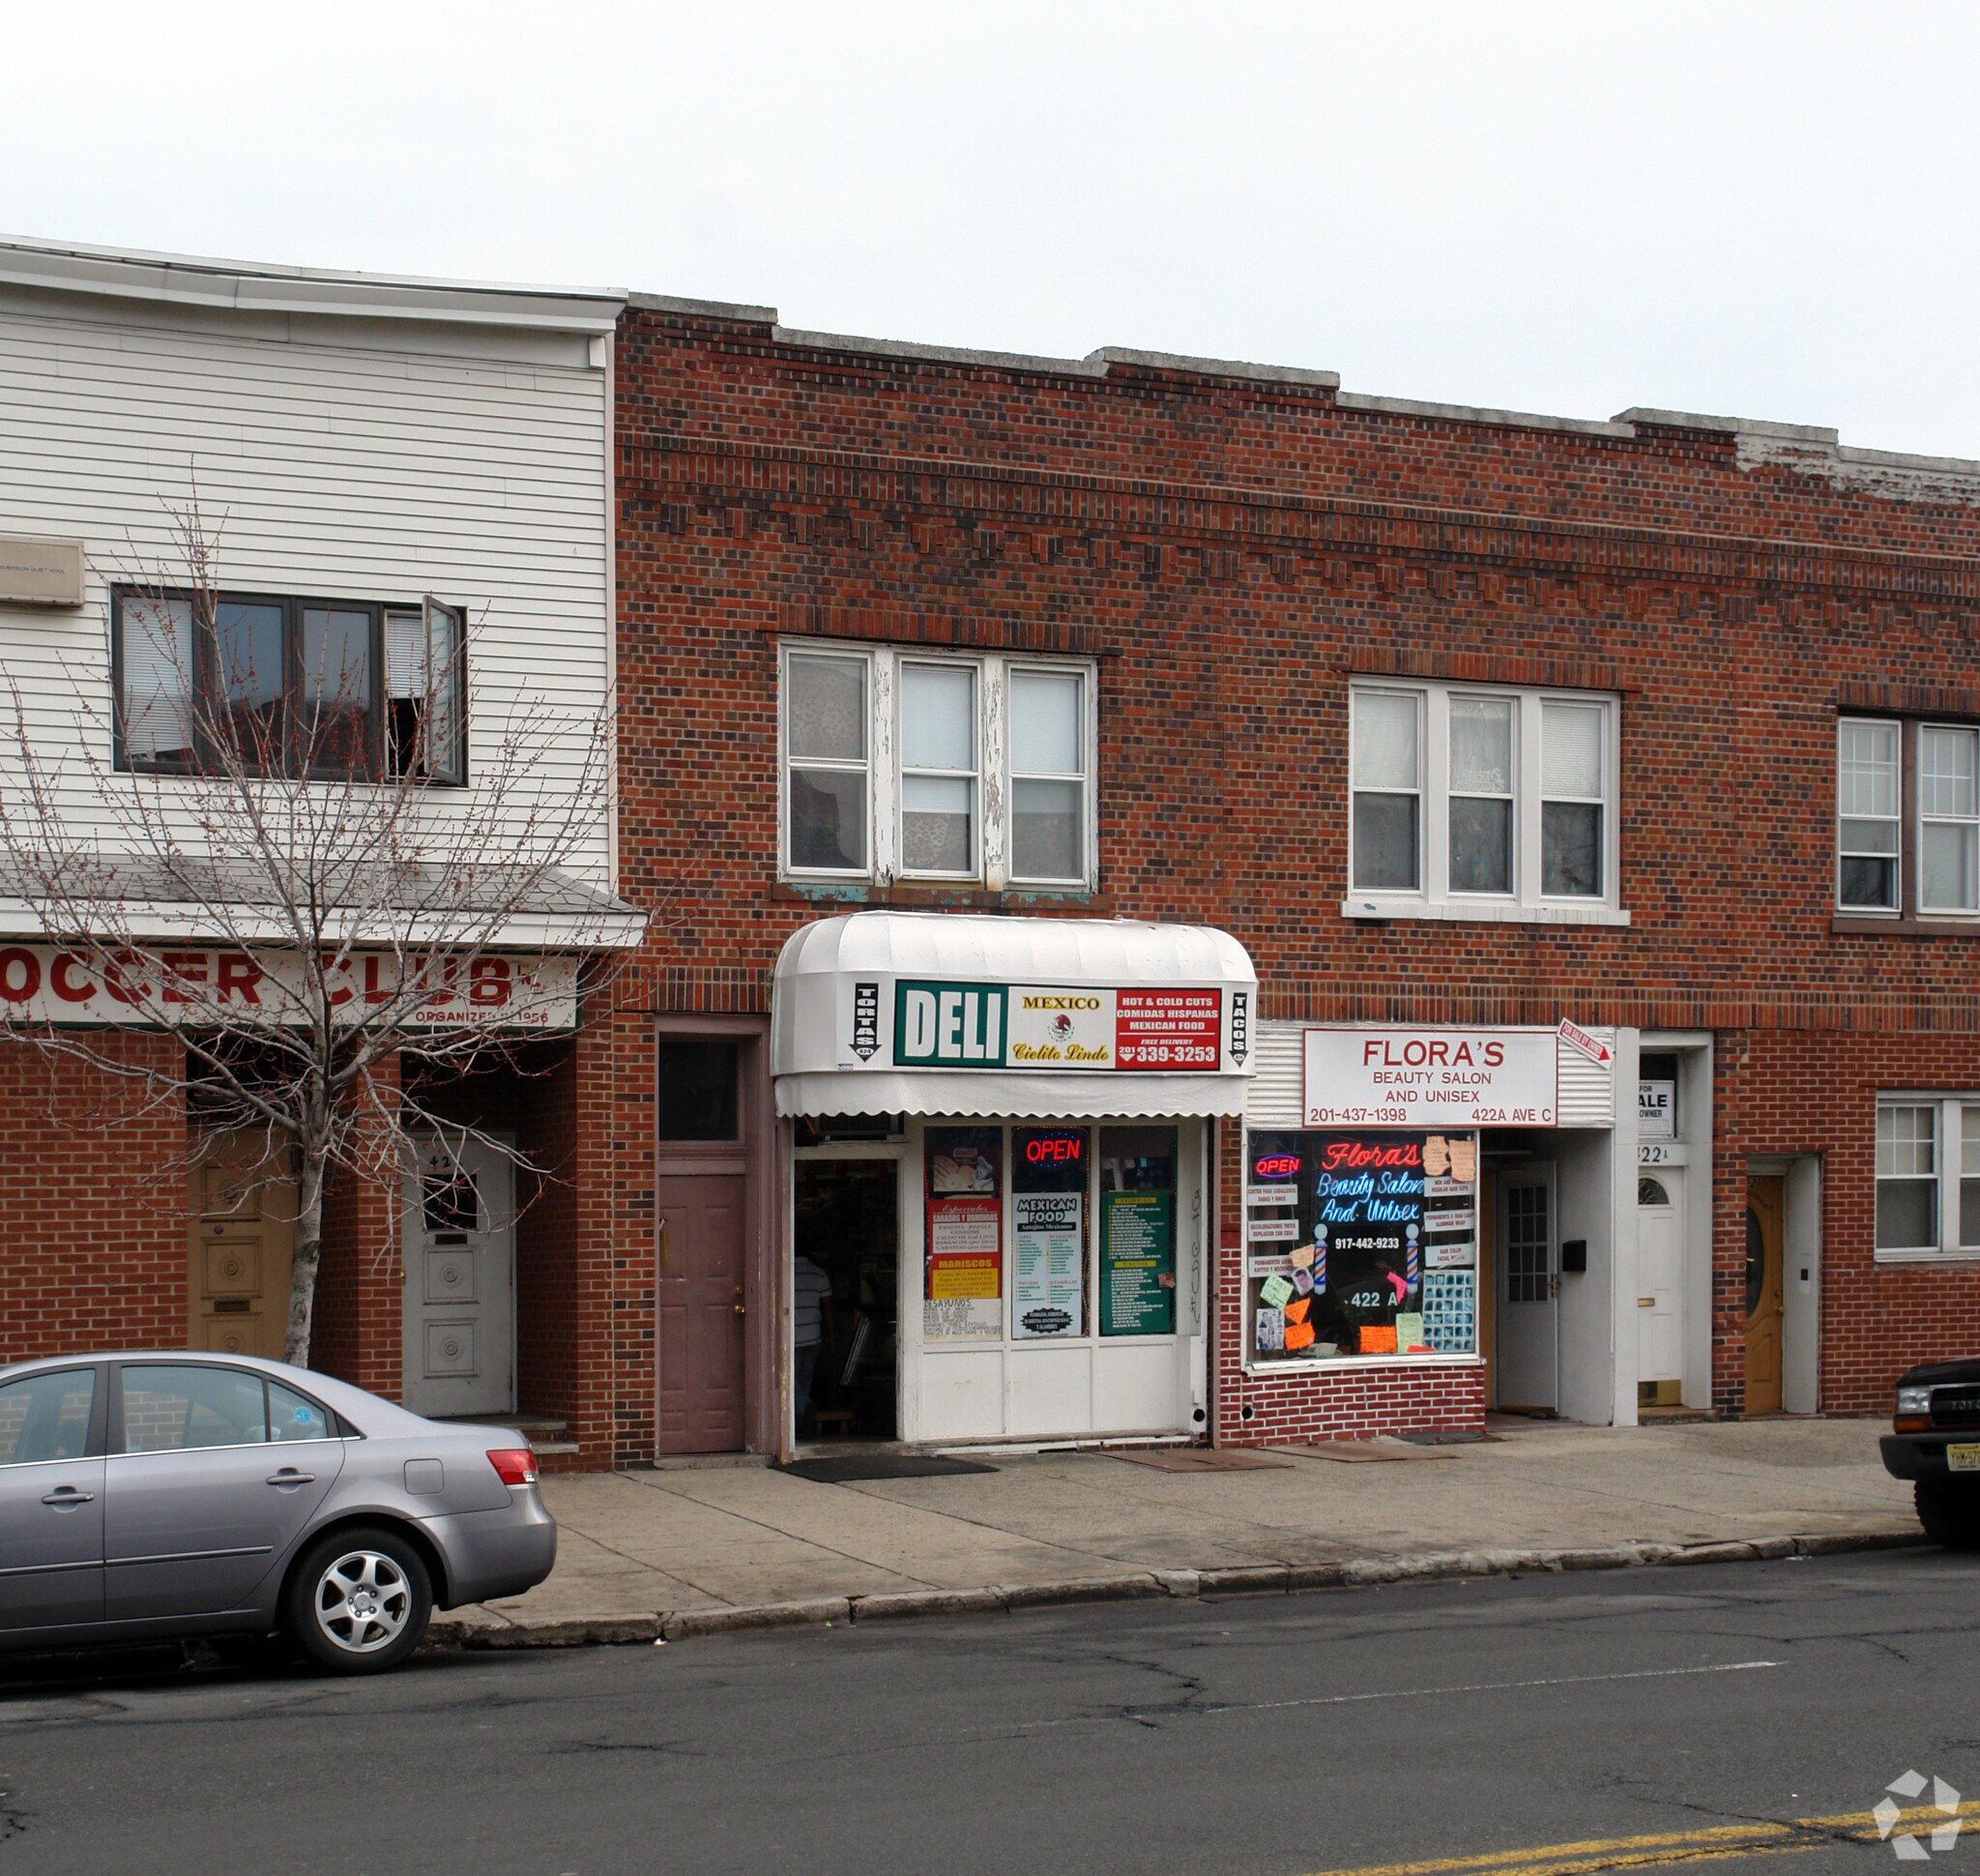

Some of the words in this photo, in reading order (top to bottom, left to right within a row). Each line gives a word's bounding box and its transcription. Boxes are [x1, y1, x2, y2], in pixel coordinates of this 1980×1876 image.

[306, 952, 513, 1007] CLUB
[1022, 996, 1100, 1010] MEXICO
[416, 1011, 496, 1023] ORGANIZE
[856, 988, 876, 1045] TORTAS
[1117, 1010, 1165, 1018] COMIDAS
[1167, 1010, 1218, 1018] HISPANAS
[905, 989, 1002, 1060] DELI
[1129, 1021, 1176, 1030] MEXICAN
[1179, 1021, 1205, 1030] FOOD
[1233, 997, 1245, 1050] TACOS
[1562, 1023, 1573, 1035] FOR
[1571, 1029, 1583, 1041] SALE
[1581, 1036, 1589, 1045] BY
[1587, 1040, 1602, 1055] OWNER
[1012, 1043, 1061, 1060] Cielito
[1063, 1044, 1109, 1061] Lindo
[1137, 1046, 1215, 1062] 339-3253
[1363, 1040, 1505, 1067] FLORA'S
[1373, 1071, 1433, 1084] BEAUTY
[1441, 1071, 1492, 1084] SALON
[1385, 1091, 1418, 1102] AND
[1426, 1091, 1480, 1102] UNISEX
[1310, 1108, 1407, 1122] 201-437-1398
[1471, 1108, 1506, 1122] 422A
[1512, 1109, 1535, 1122] AVE
[1542, 1109, 1552, 1122] C
[1639, 1109, 1662, 1118] OWNER
[1026, 1139, 1081, 1161] OPEN
[1322, 1142, 1421, 1170] Flora's
[1638, 1146, 1661, 1162] 22
[1256, 1158, 1300, 1174] OPEN
[1317, 1171, 1375, 1203] Beauty
[1378, 1171, 1424, 1197] Salon
[1018, 1199, 1077, 1212] MEXICAN
[1321, 1198, 1358, 1222] And
[1367, 1199, 1420, 1222] Unisex
[1029, 1211, 1065, 1223] FOOD
[1335, 1238, 1399, 1249] 917-442-9233
[939, 1259, 992, 1268] MARISCOS
[1351, 1292, 1380, 1306] 422
[1387, 1292, 1398, 1305] A
